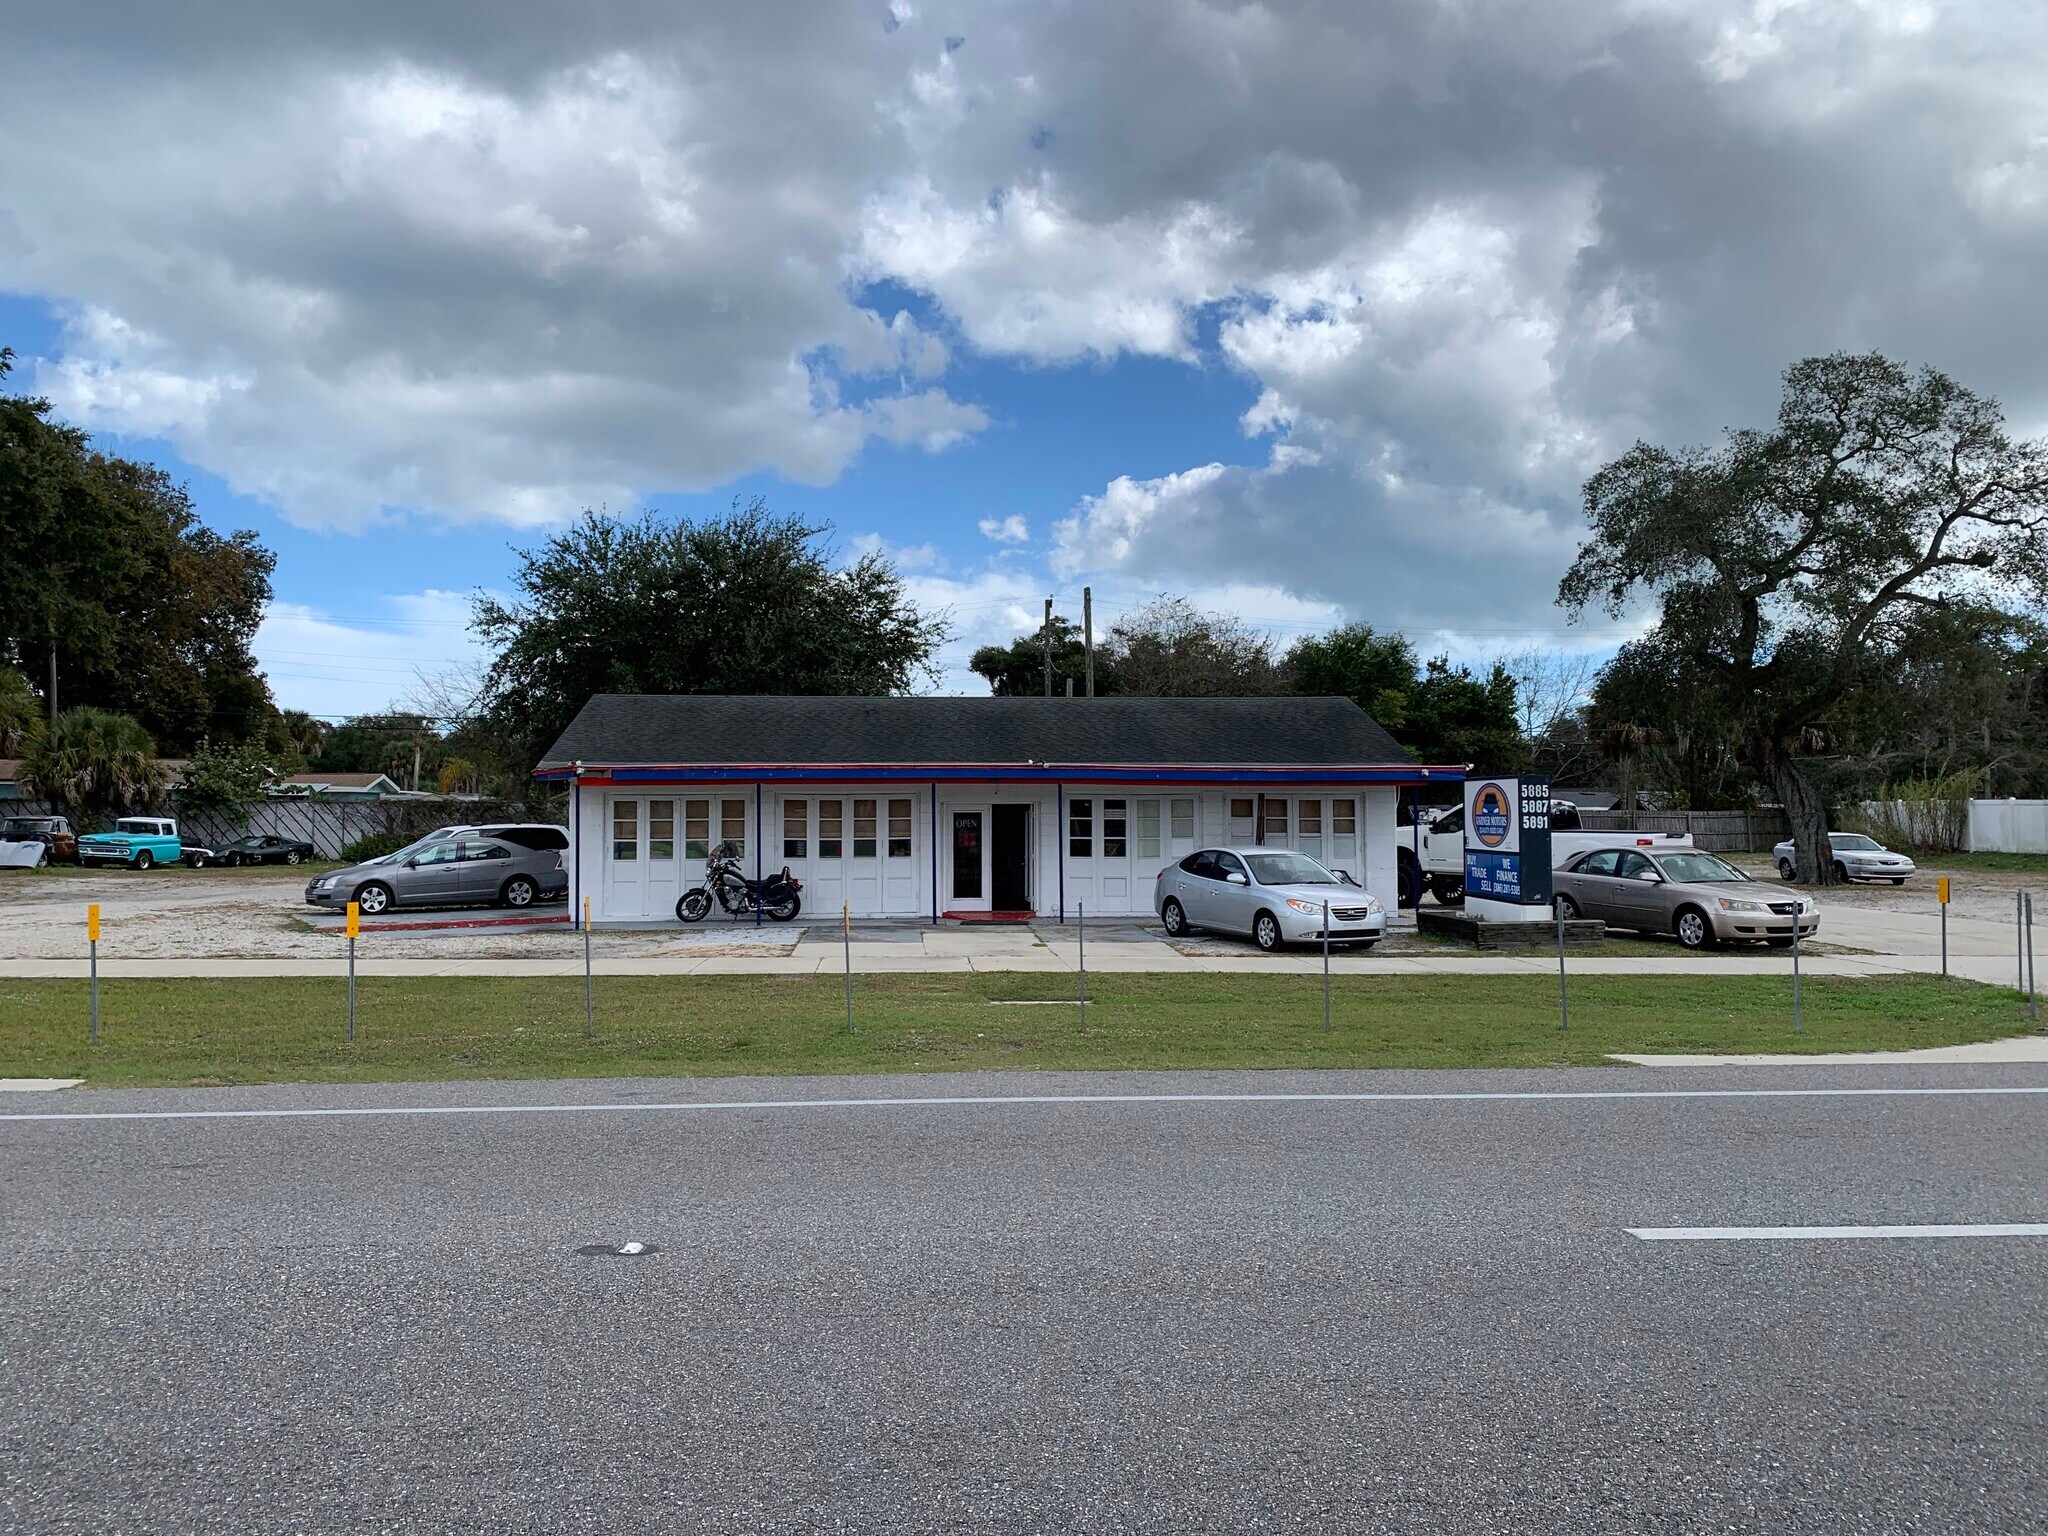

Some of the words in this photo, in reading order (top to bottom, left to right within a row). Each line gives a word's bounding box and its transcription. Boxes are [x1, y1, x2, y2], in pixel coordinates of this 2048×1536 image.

[1521, 784, 1549, 797] 5885
[1522, 800, 1549, 813] 5887
[956, 819, 977, 828] OPEN
[1491, 816, 1507, 826] MOTORS
[1523, 816, 1548, 829] 5891
[1467, 854, 1477, 865] BUY
[1502, 858, 1511, 870] WE
[1471, 867, 1487, 879] TRADE
[1496, 870, 1518, 883] FINANCE
[1481, 880, 1492, 891] SELL
